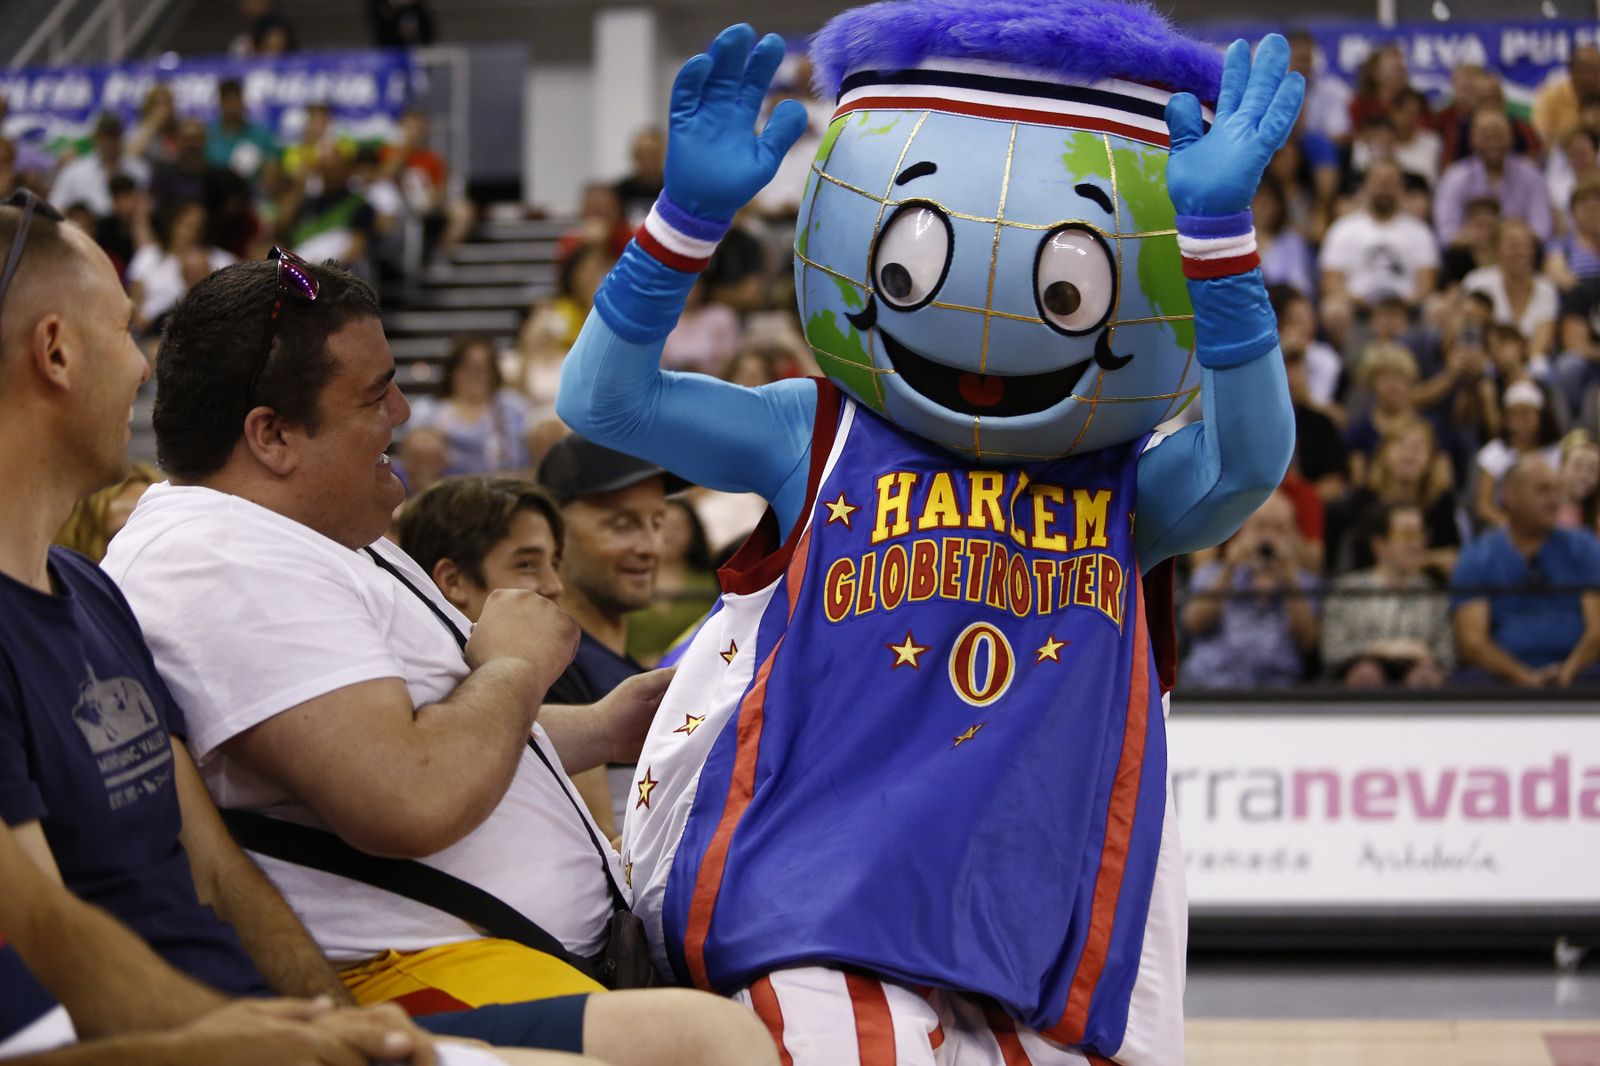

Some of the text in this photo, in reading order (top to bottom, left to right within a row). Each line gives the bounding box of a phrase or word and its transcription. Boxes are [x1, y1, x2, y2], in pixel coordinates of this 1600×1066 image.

[870, 470, 1113, 552] HARLEM
[823, 537, 1129, 636] GLOBETROTTER
[948, 621, 1016, 707] 0
